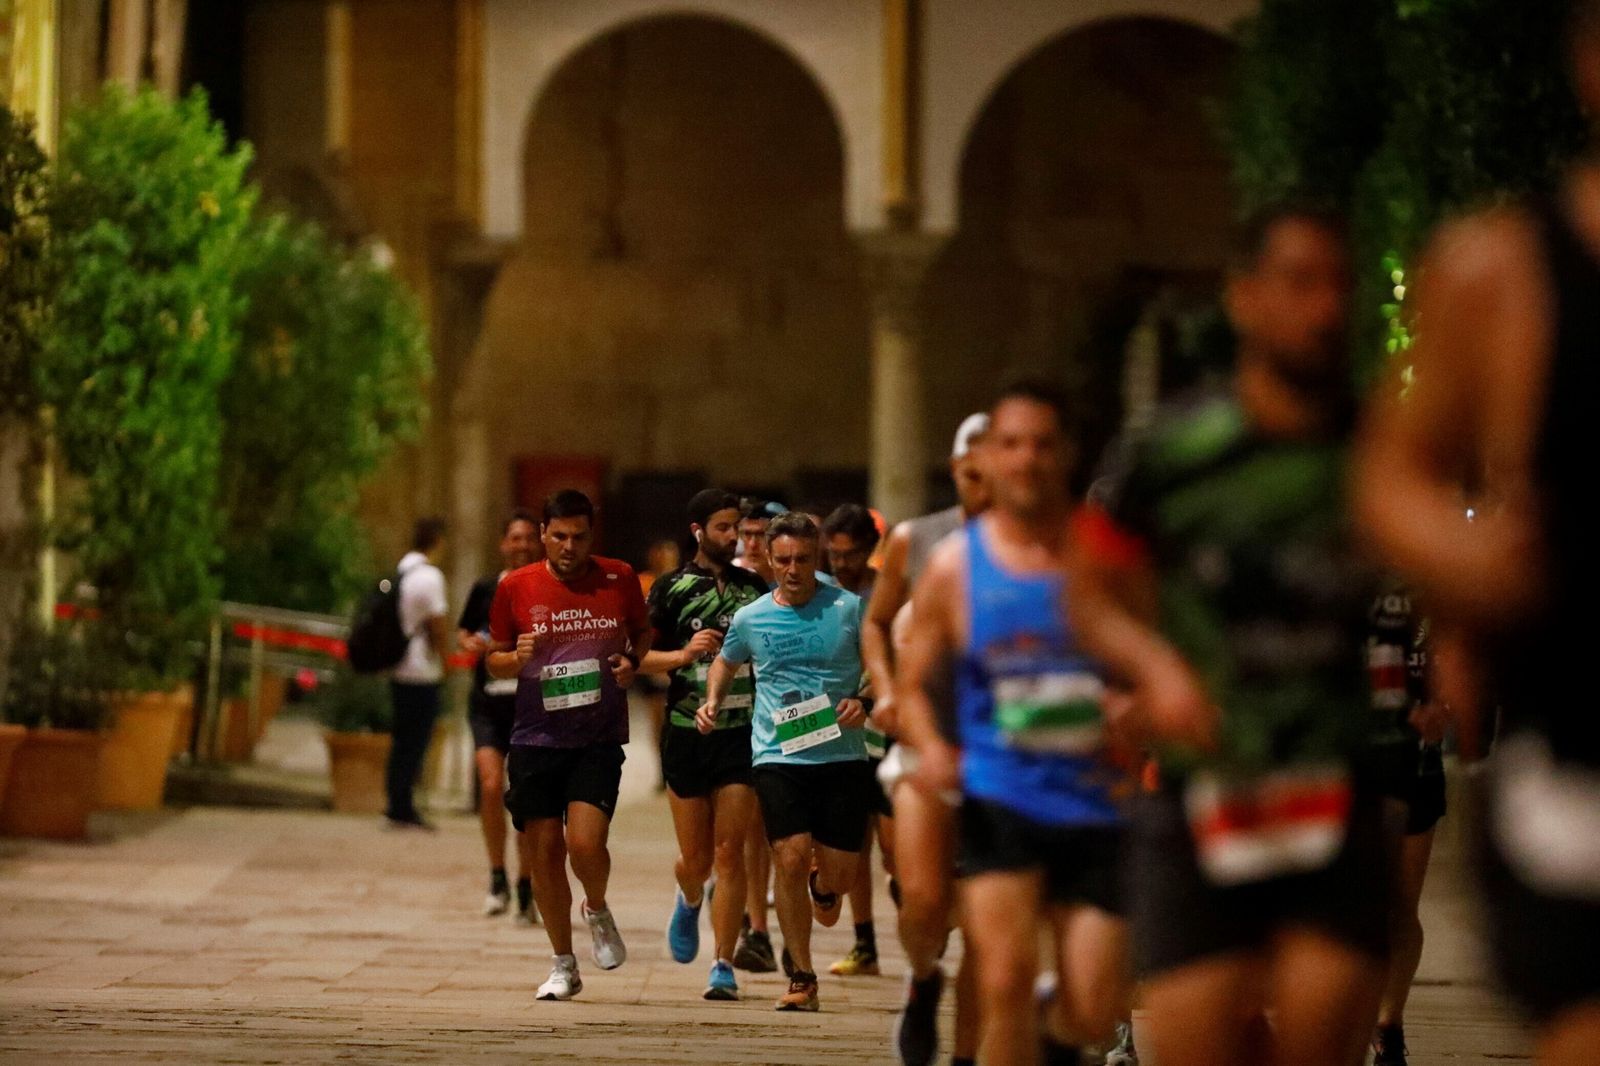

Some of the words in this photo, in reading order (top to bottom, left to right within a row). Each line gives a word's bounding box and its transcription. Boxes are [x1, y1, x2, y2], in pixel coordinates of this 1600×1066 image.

[551, 608, 592, 622] MEDIA
[531, 622, 548, 634] 36
[552, 615, 618, 633] MARATÓN
[556, 665, 568, 677] 20
[558, 675, 585, 692] 548
[786, 707, 798, 720] 20
